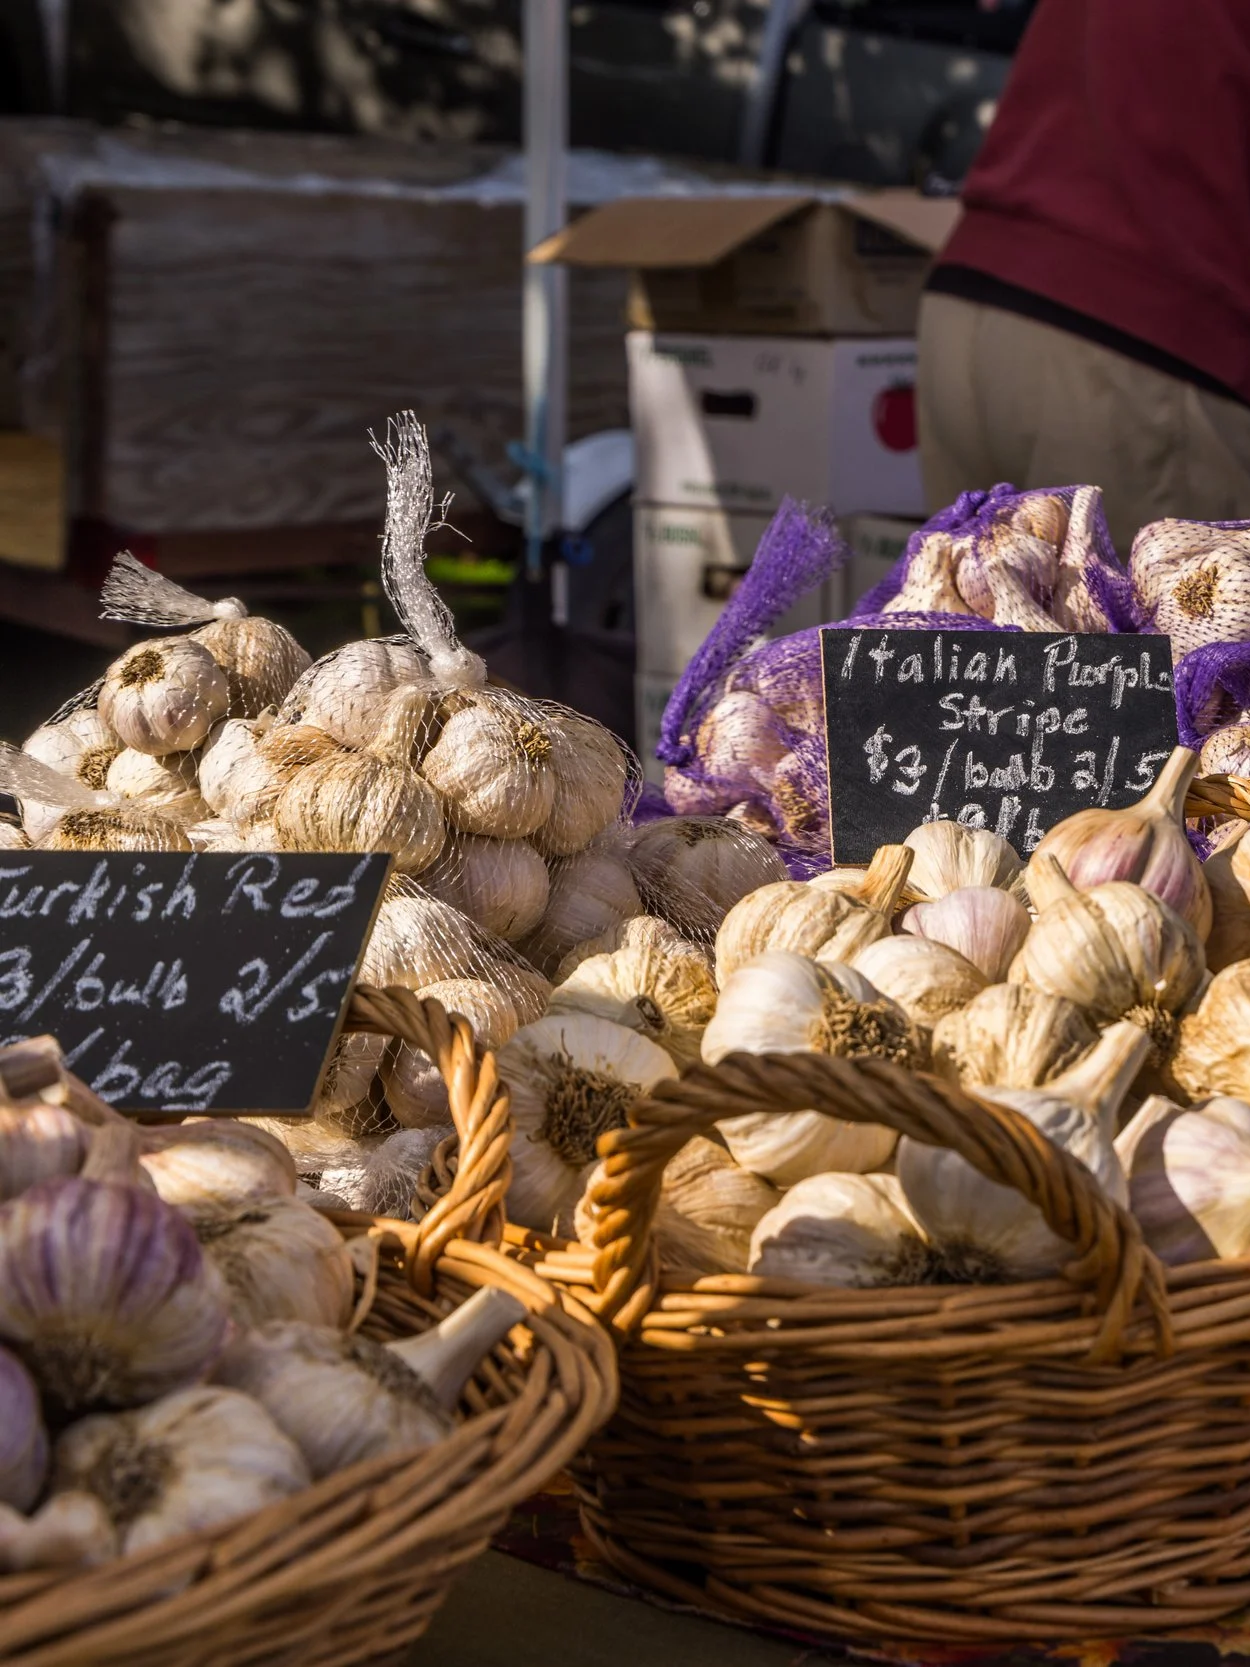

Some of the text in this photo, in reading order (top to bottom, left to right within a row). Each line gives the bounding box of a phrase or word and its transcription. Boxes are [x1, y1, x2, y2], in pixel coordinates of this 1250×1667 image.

[841, 632, 1018, 684] Italian
[938, 692, 1089, 752] Stripe
[221, 853, 374, 919] Red
